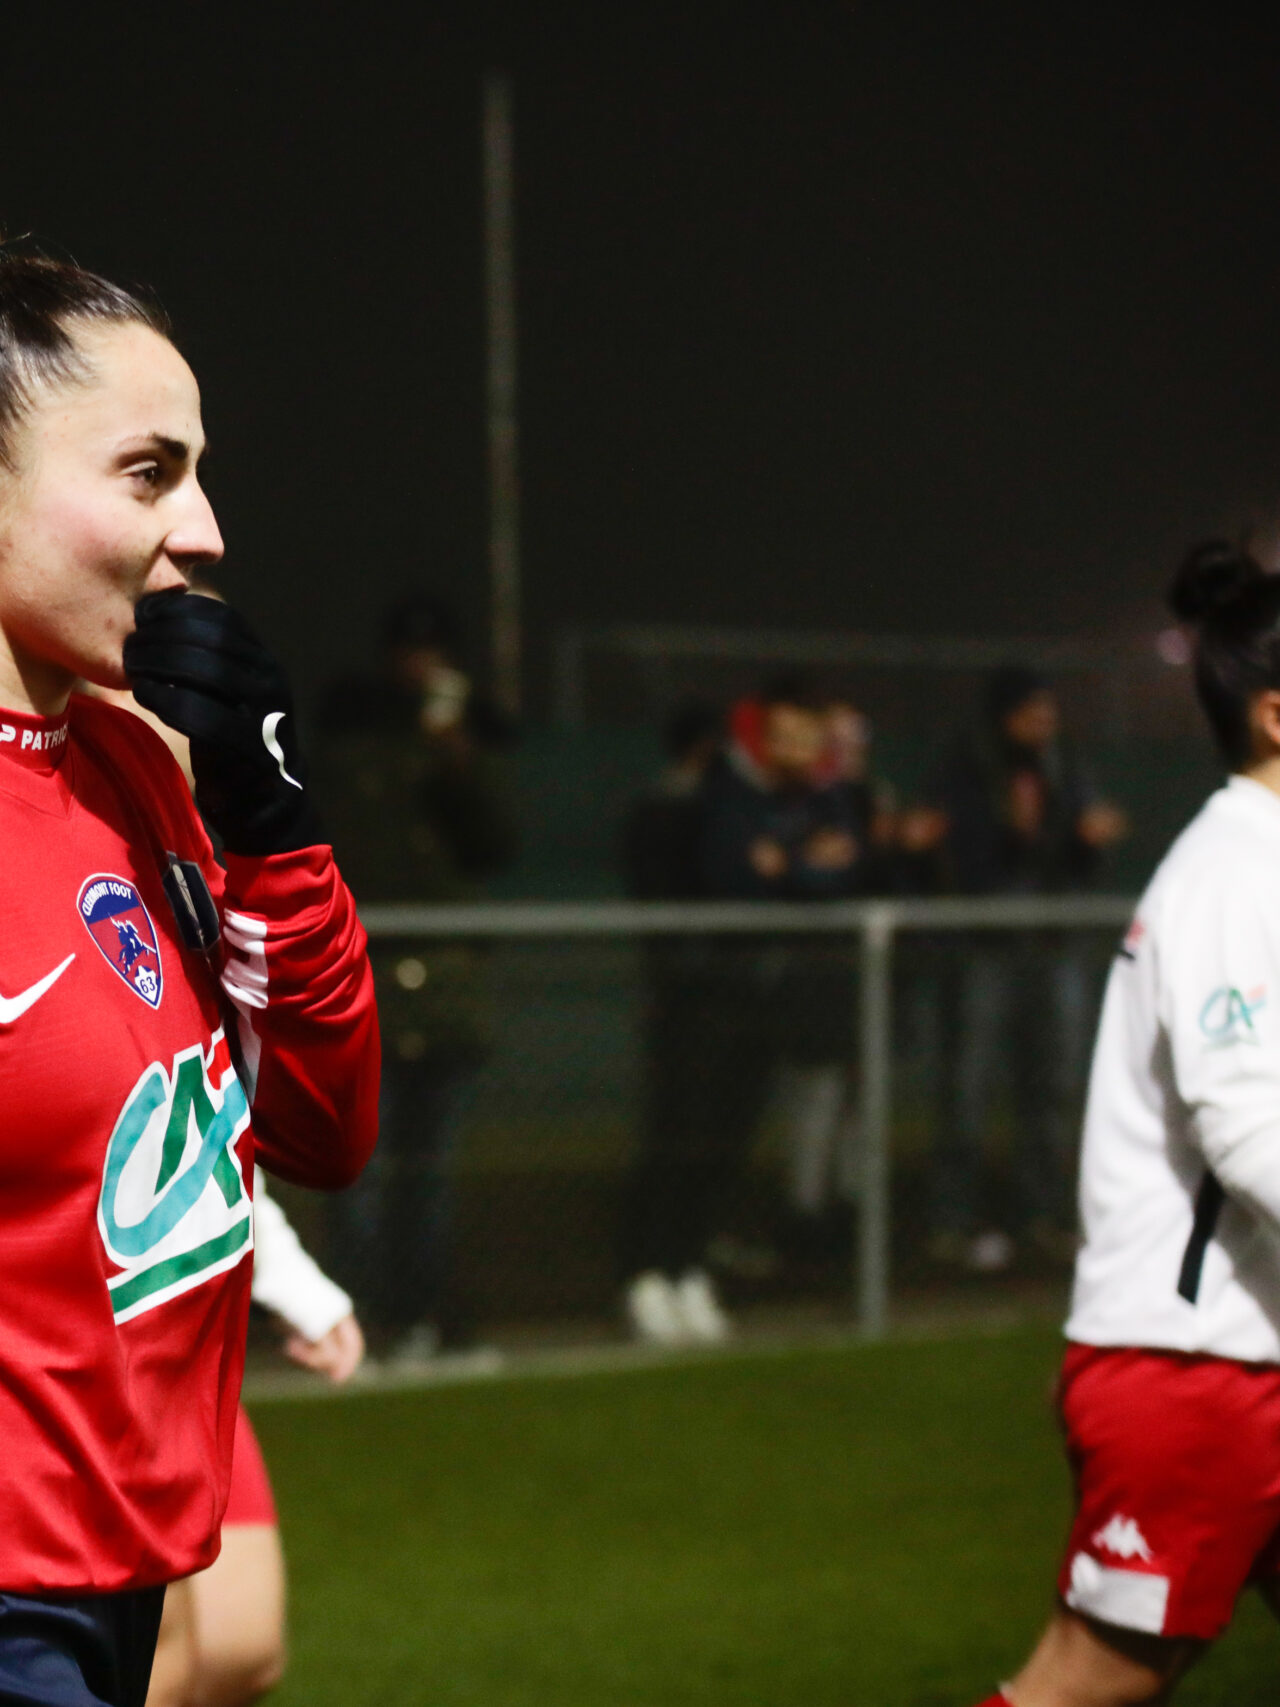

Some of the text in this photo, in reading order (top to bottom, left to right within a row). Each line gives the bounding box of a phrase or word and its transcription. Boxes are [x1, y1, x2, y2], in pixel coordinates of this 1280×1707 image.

[81, 881, 132, 917] CLERMONT FOOT
[139, 976, 156, 994] 63
